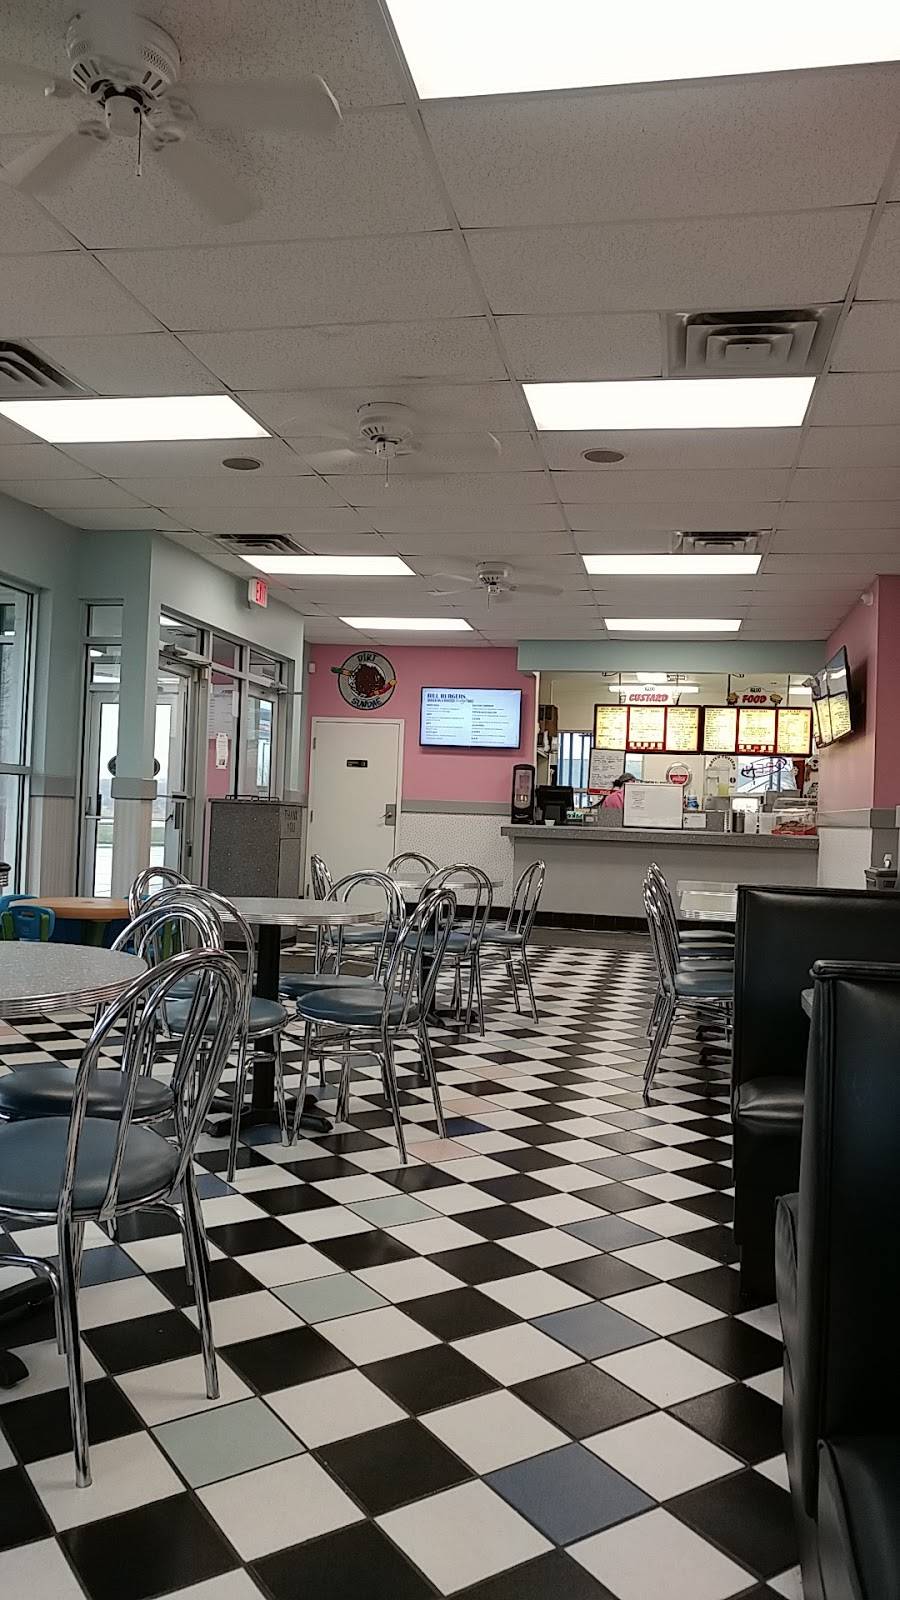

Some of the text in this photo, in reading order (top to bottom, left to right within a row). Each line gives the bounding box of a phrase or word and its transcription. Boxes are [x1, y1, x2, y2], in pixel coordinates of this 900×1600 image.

[357, 653, 376, 662] DIRT
[628, 693, 669, 702] CUSTARD
[741, 694, 767, 704] FOOD
[351, 697, 381, 708] SUNDAE
